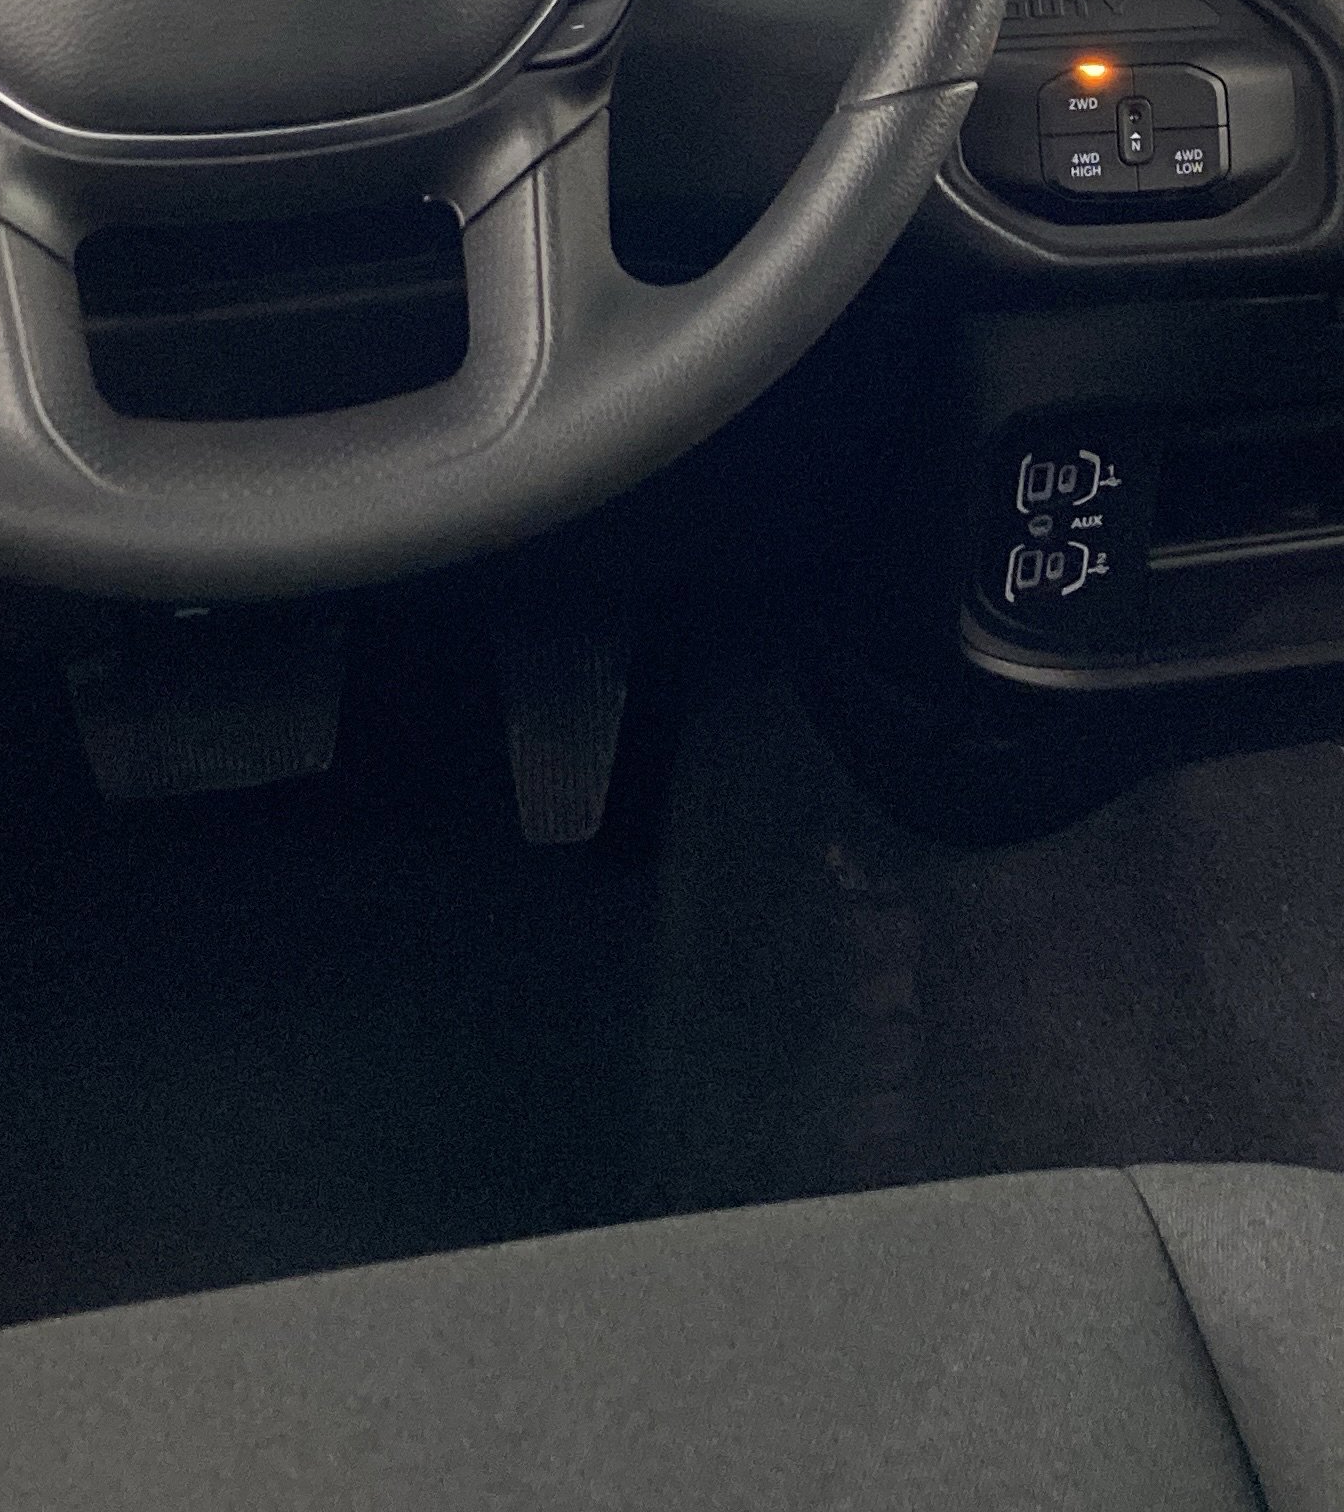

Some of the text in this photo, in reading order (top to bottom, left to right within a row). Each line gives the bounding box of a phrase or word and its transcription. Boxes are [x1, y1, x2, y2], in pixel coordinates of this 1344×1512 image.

[1068, 98, 1099, 111] 2WD
[1131, 140, 1142, 152] N
[1071, 152, 1100, 165] 4WD
[1174, 149, 1204, 162] 4WD
[1070, 164, 1102, 178] HIGH
[1175, 161, 1204, 175] LOW
[1070, 514, 1104, 530] AUX
